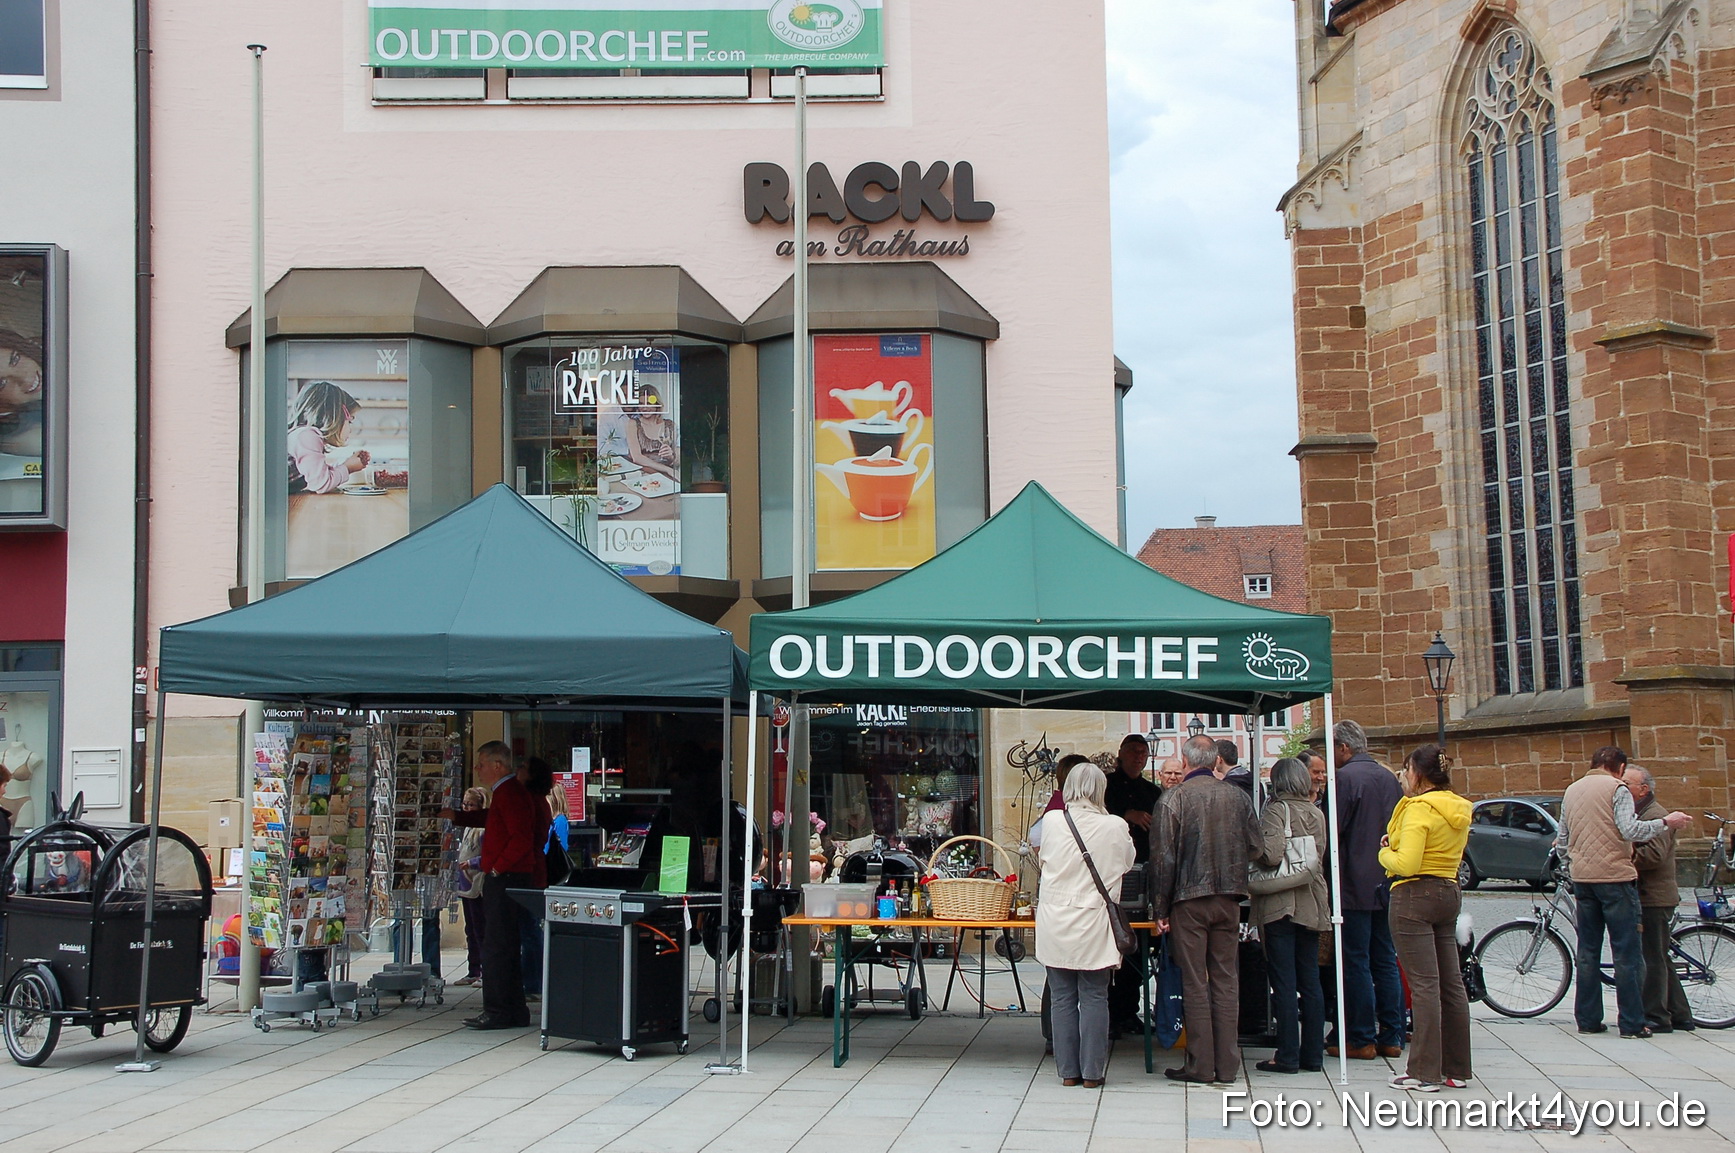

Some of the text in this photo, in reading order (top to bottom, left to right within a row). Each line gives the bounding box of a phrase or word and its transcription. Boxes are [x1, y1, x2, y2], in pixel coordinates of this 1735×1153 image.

[775, 20, 857, 45] OUTDOORCHEF
[782, 53, 828, 61] BARBECUE
[829, 53, 869, 61] COMPANY
[744, 161, 995, 224] RACKL
[834, 224, 970, 257] Rathaus
[569, 345, 653, 366] 100 Jahre
[563, 369, 640, 405] RACKL
[601, 527, 678, 552] 100 Jahre
[769, 634, 1218, 680] OUTDOORCHEF
[268, 723, 291, 733] Kultura
[300, 723, 337, 733] Kultura
